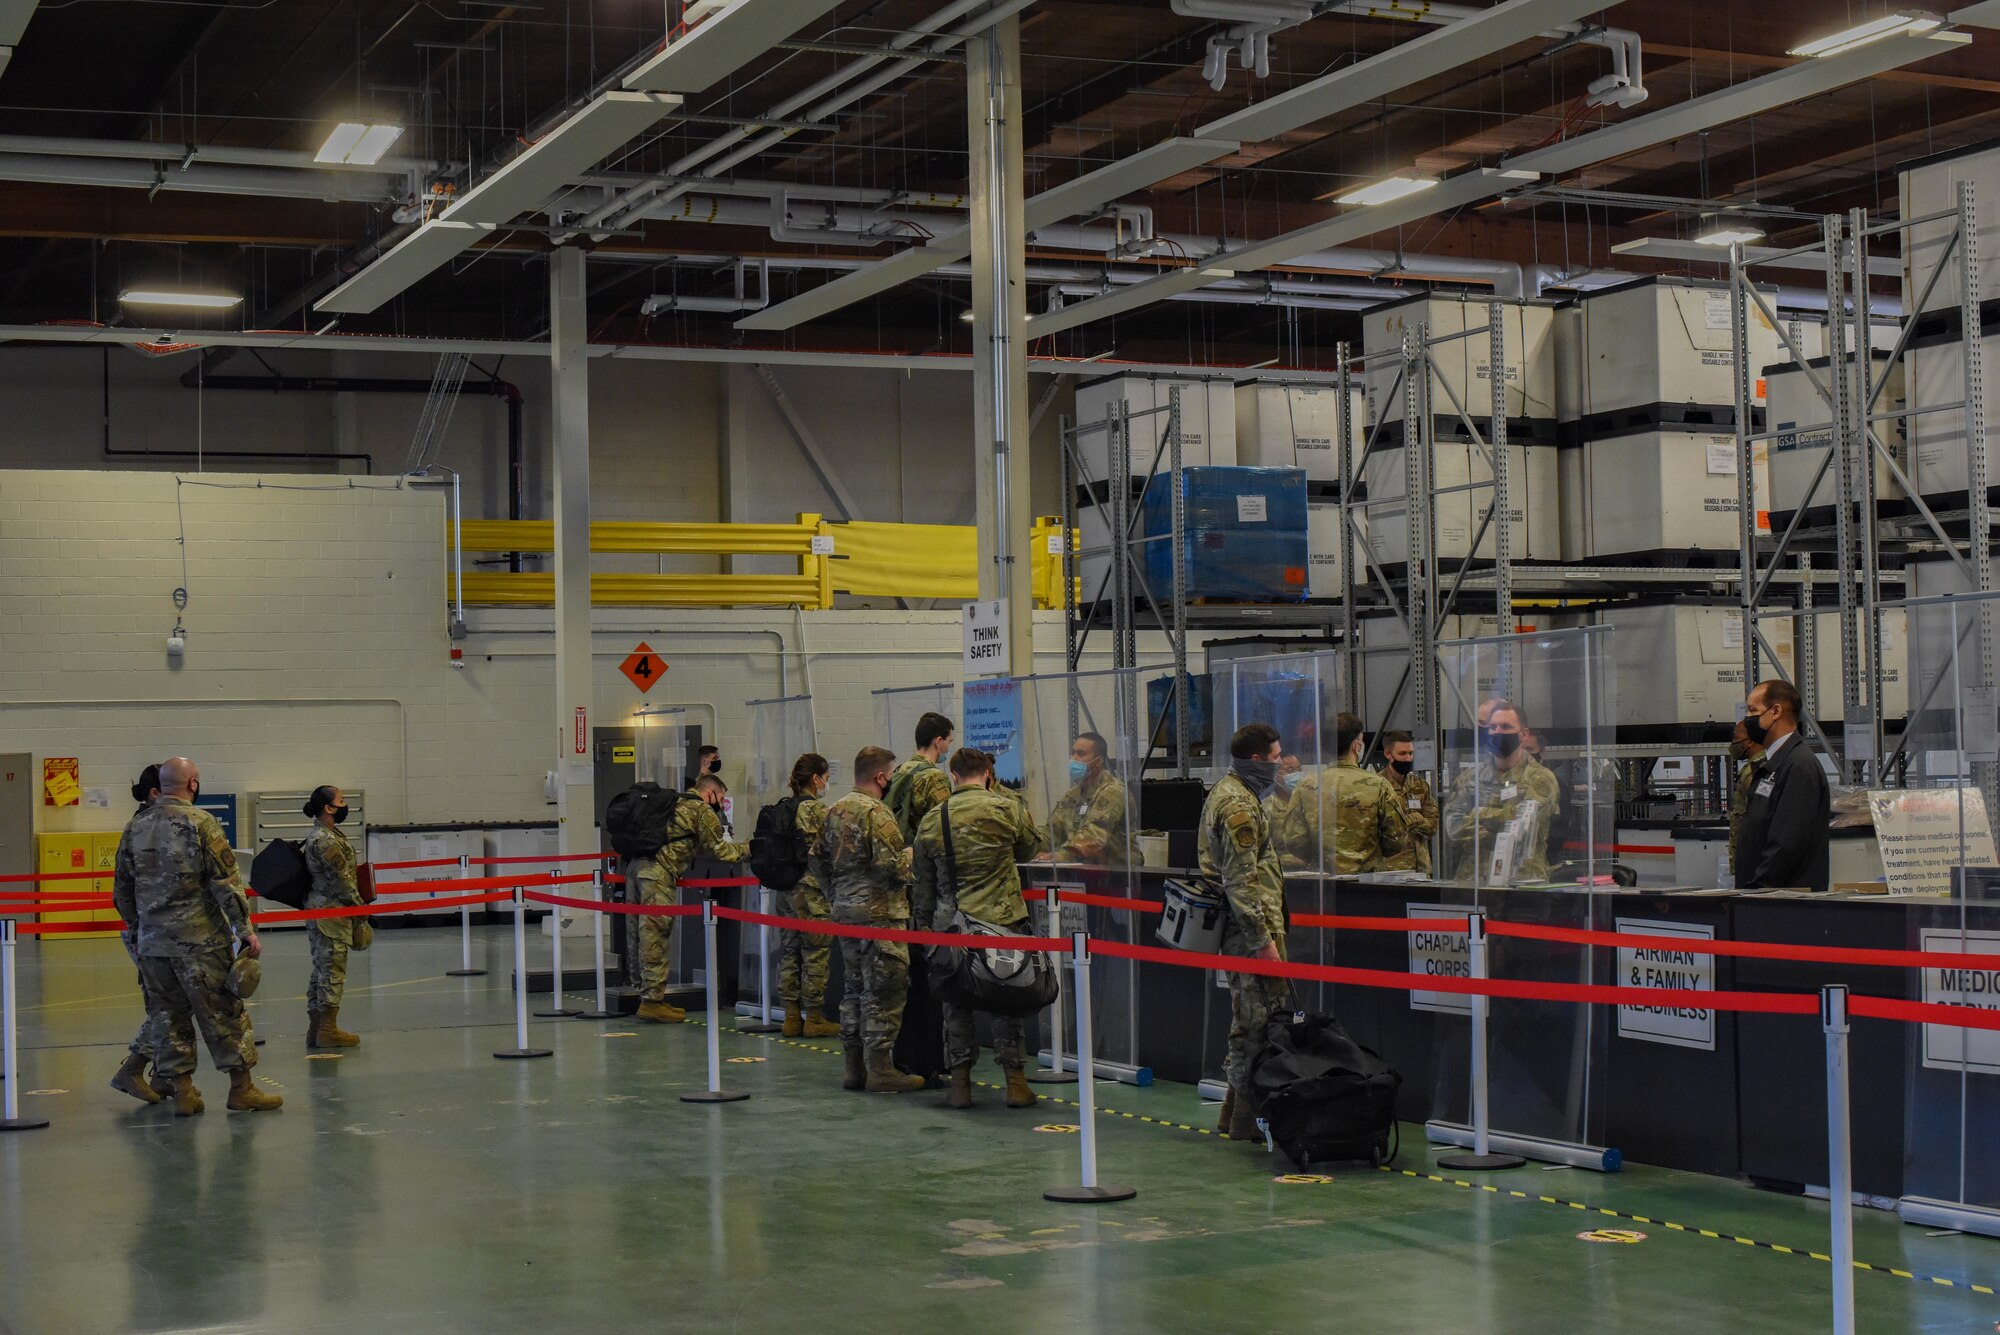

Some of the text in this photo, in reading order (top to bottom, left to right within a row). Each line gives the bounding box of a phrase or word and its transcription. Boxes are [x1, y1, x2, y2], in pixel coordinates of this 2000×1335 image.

[1778, 436, 1795, 447] GSA
[1799, 432, 1831, 444] Contract
[973, 626, 999, 641] THINK
[971, 643, 1002, 659] SAFETY
[634, 656, 652, 678] 4
[986, 721, 1000, 729] Number
[970, 732, 1007, 742] Deployment Location
[6, 773, 14, 781] 17
[1881, 834, 1903, 842] Please
[1904, 833, 1926, 841] advise
[1927, 831, 1953, 840] medical
[1891, 848, 1904, 856] you
[1918, 844, 1949, 854] currently
[1886, 860, 1922, 868] treatment,
[1924, 858, 1941, 866] have
[1889, 872, 1926, 881] conditions
[1927, 871, 1940, 879] that
[1892, 886, 1901, 894] by
[1902, 885, 1913, 893] the
[1426, 958, 1470, 977] CORPS
[1631, 966, 1700, 990] & FAMILY
